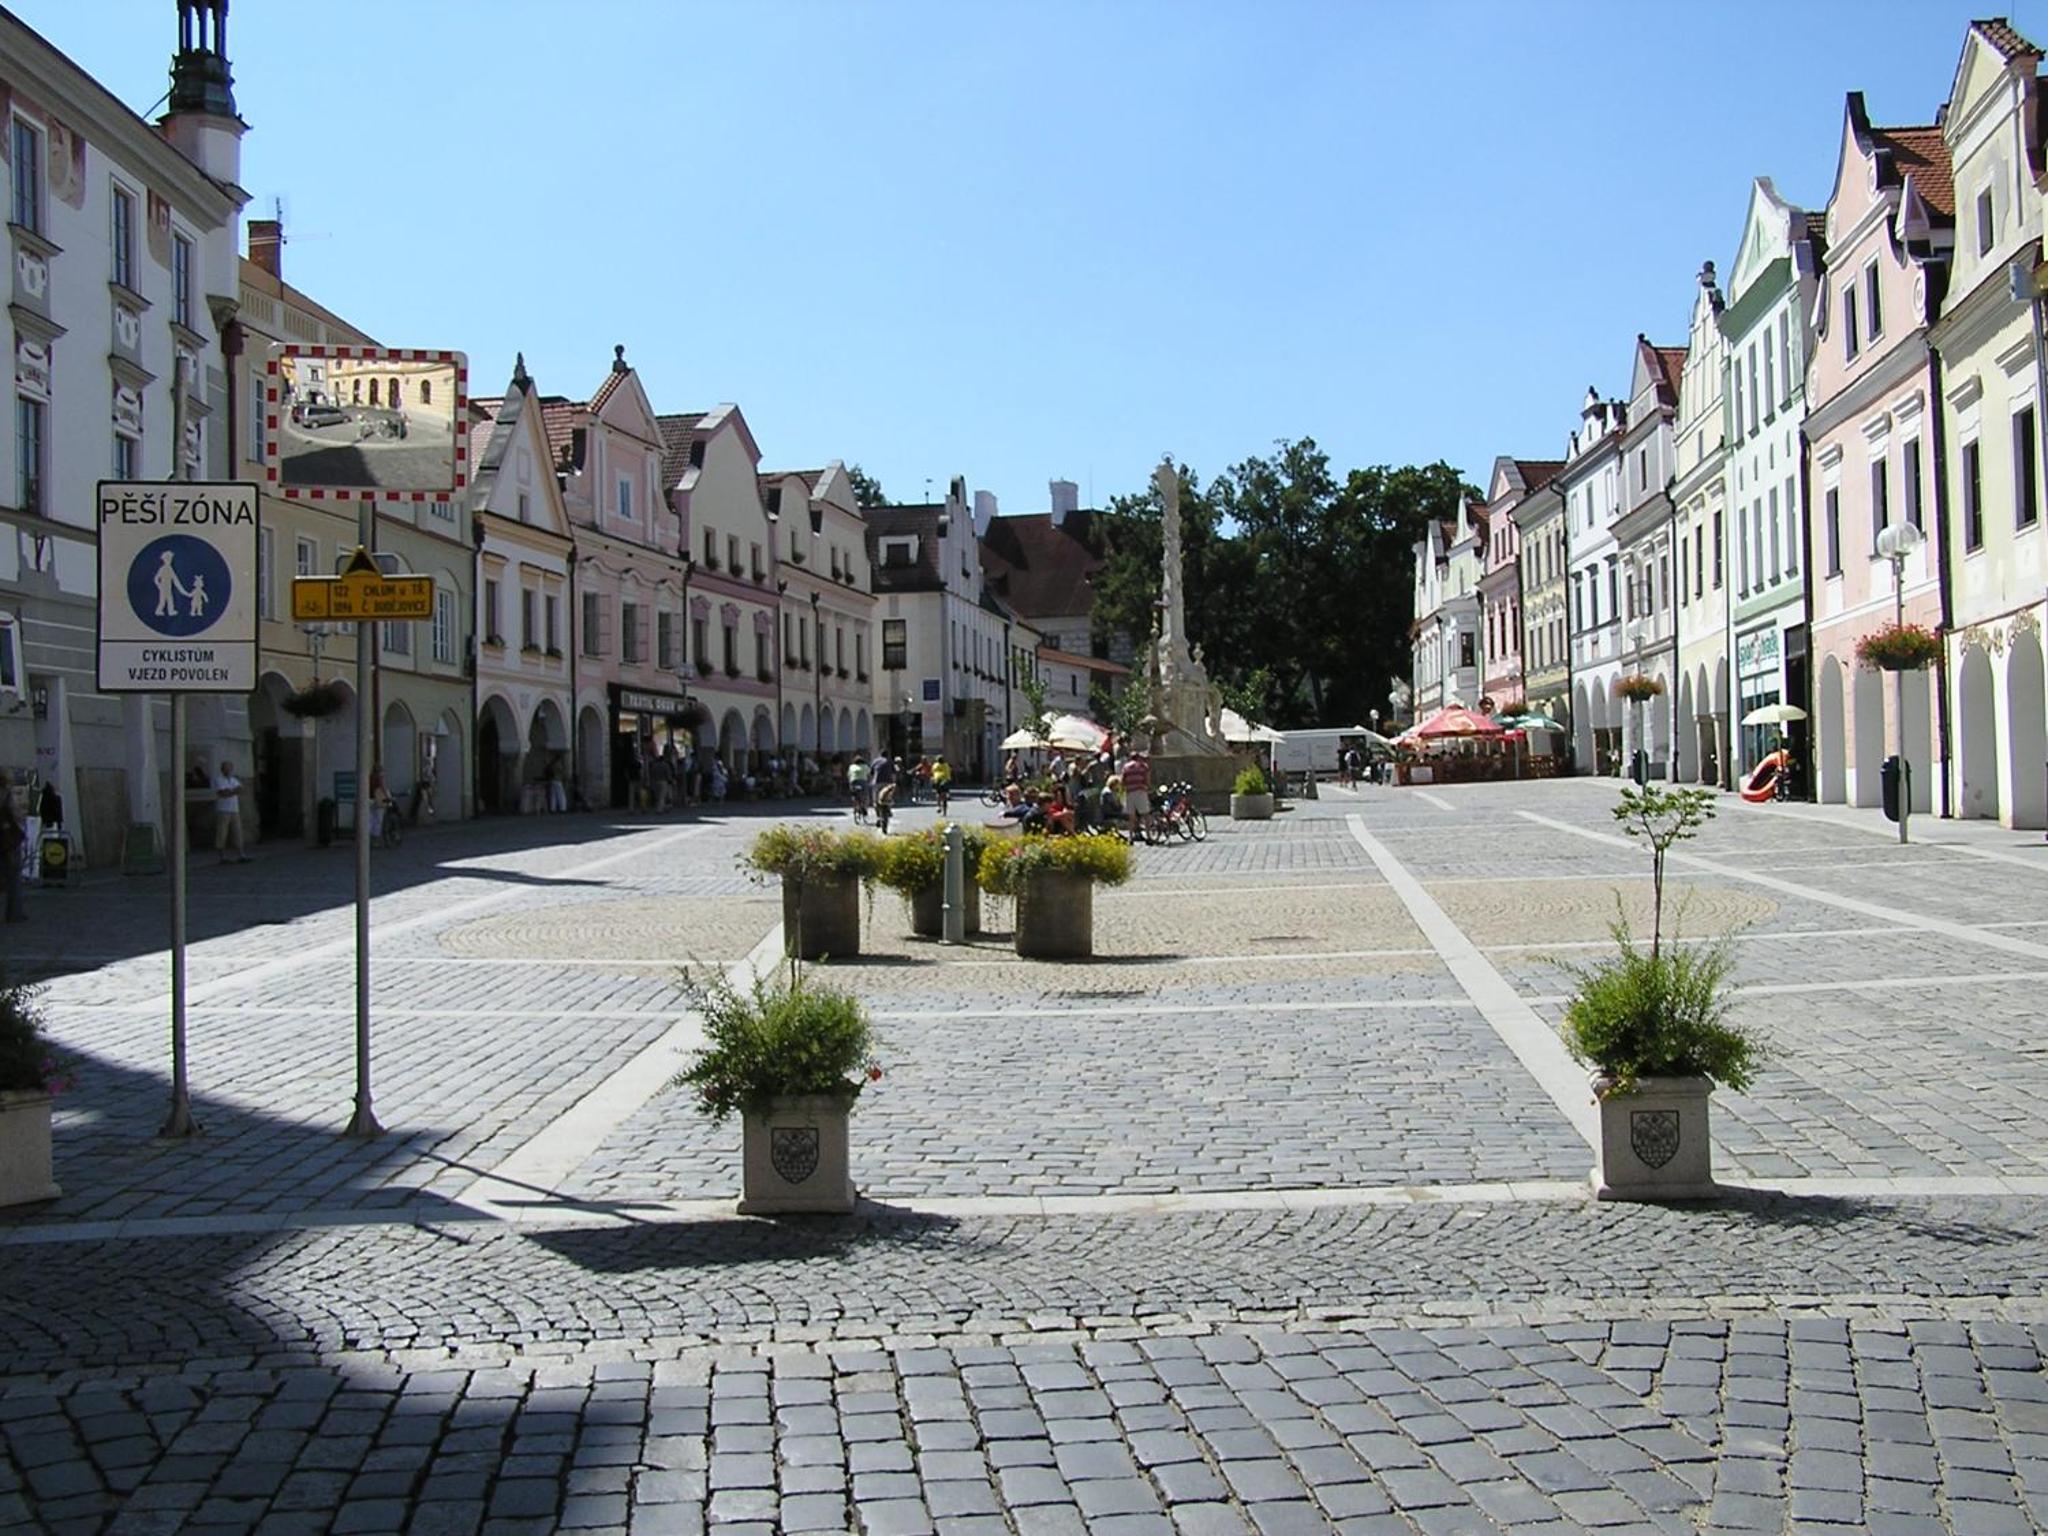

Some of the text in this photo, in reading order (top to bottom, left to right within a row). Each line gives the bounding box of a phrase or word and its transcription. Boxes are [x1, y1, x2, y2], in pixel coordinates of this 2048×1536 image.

[102, 492, 254, 525] PĚŠÍ ZÓNA
[334, 586, 349, 598] 122
[374, 599, 425, 613] BUDĚJOVICE
[128, 667, 229, 681] VJEZD POVOLEN
